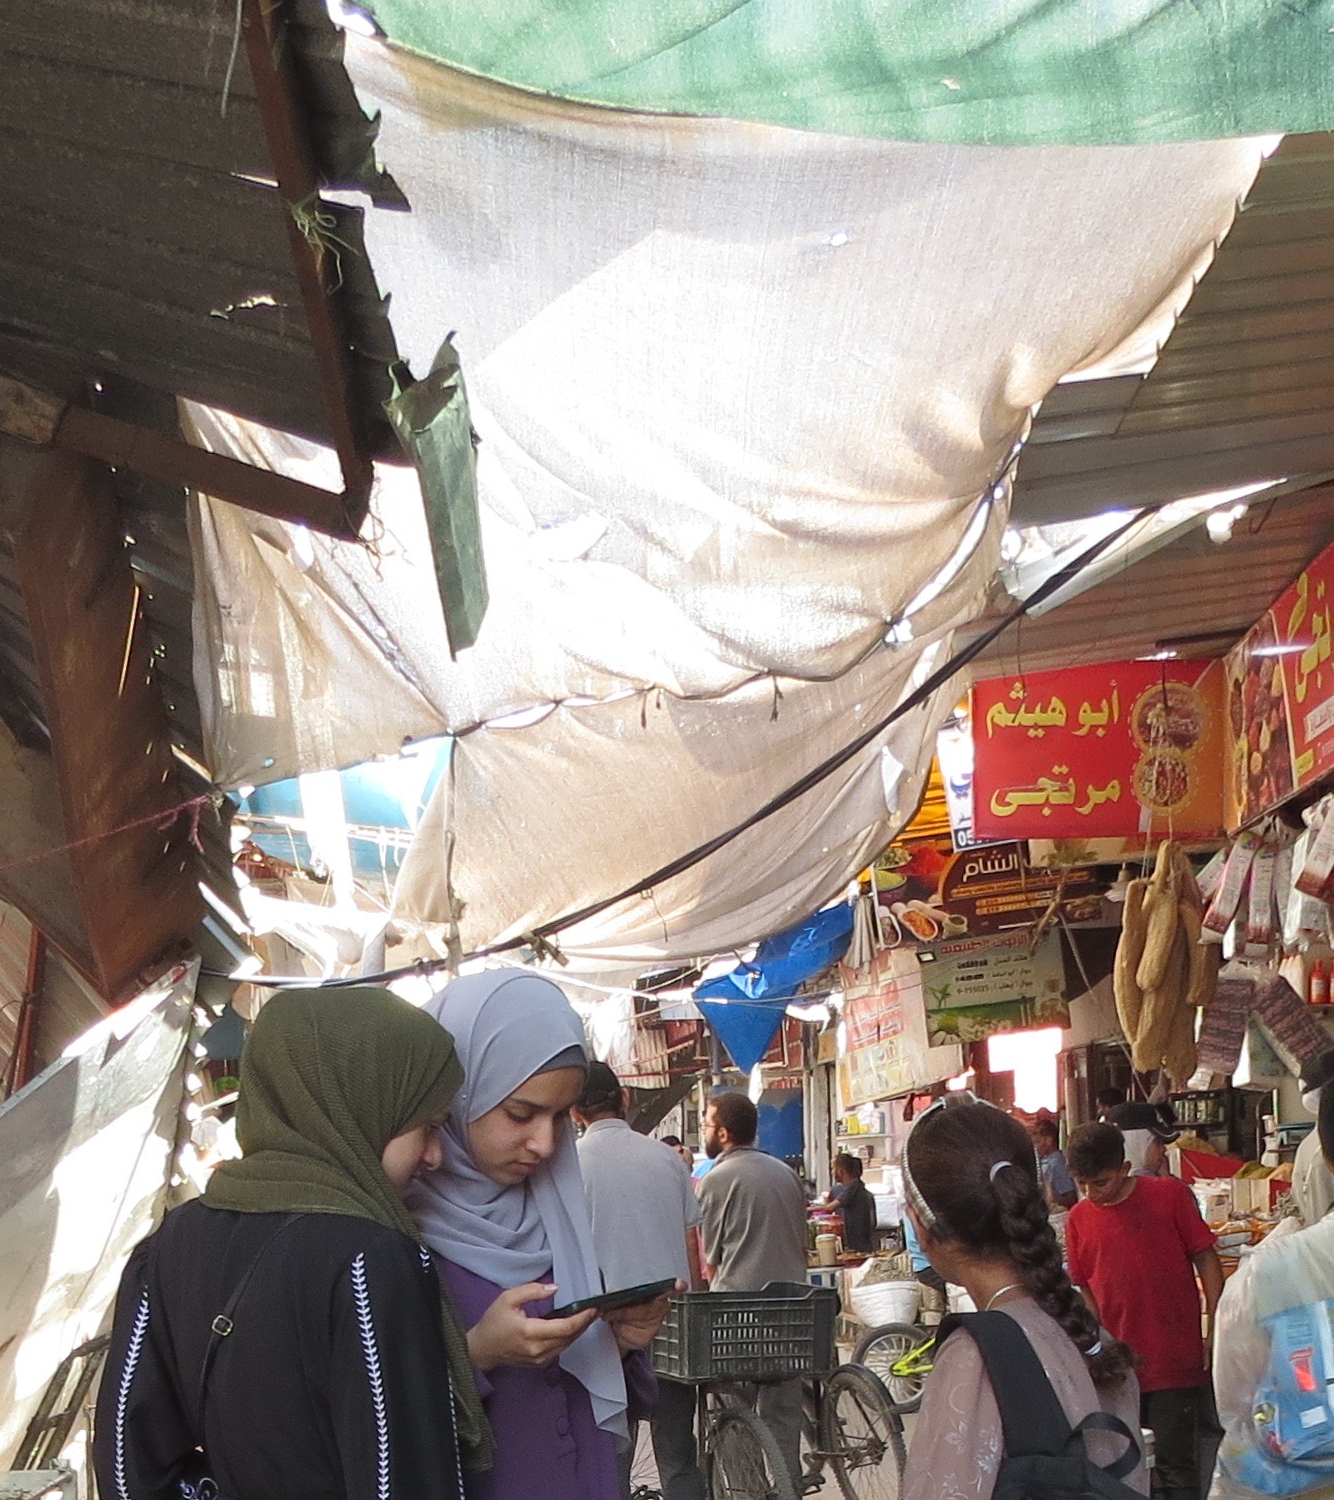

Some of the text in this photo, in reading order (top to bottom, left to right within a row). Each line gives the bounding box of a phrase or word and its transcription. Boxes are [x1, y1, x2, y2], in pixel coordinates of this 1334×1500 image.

[984, 679, 1120, 740] أبو هيثم
[989, 764, 1122, 818] مرتجى
[962, 850, 1019, 883] الشام
